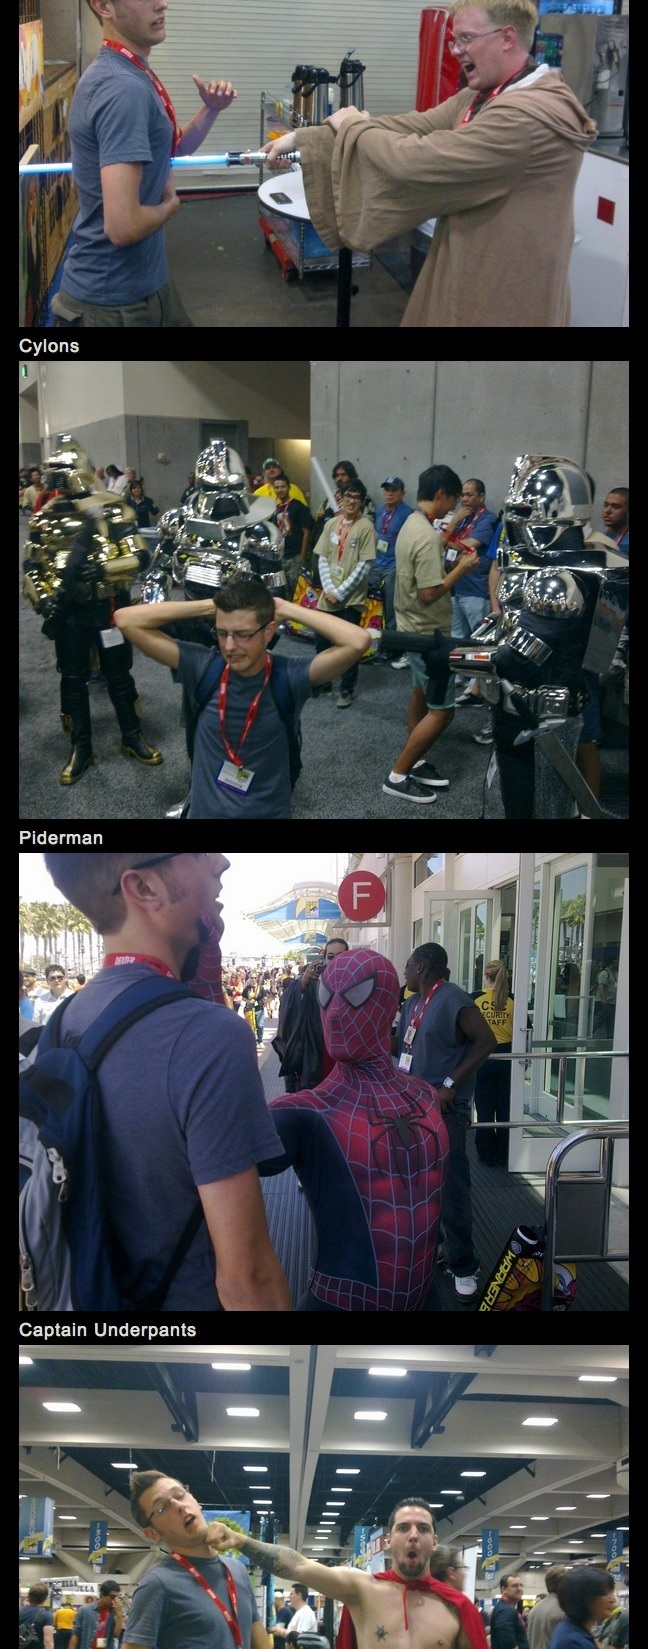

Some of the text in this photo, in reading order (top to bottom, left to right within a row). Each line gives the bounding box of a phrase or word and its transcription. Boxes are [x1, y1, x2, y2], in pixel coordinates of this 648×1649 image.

[353, 882, 372, 910] F
[115, 956, 136, 966] DEXTER
[482, 1012, 511, 1020] ECURITY
[94, 1522, 102, 1549] 1300
